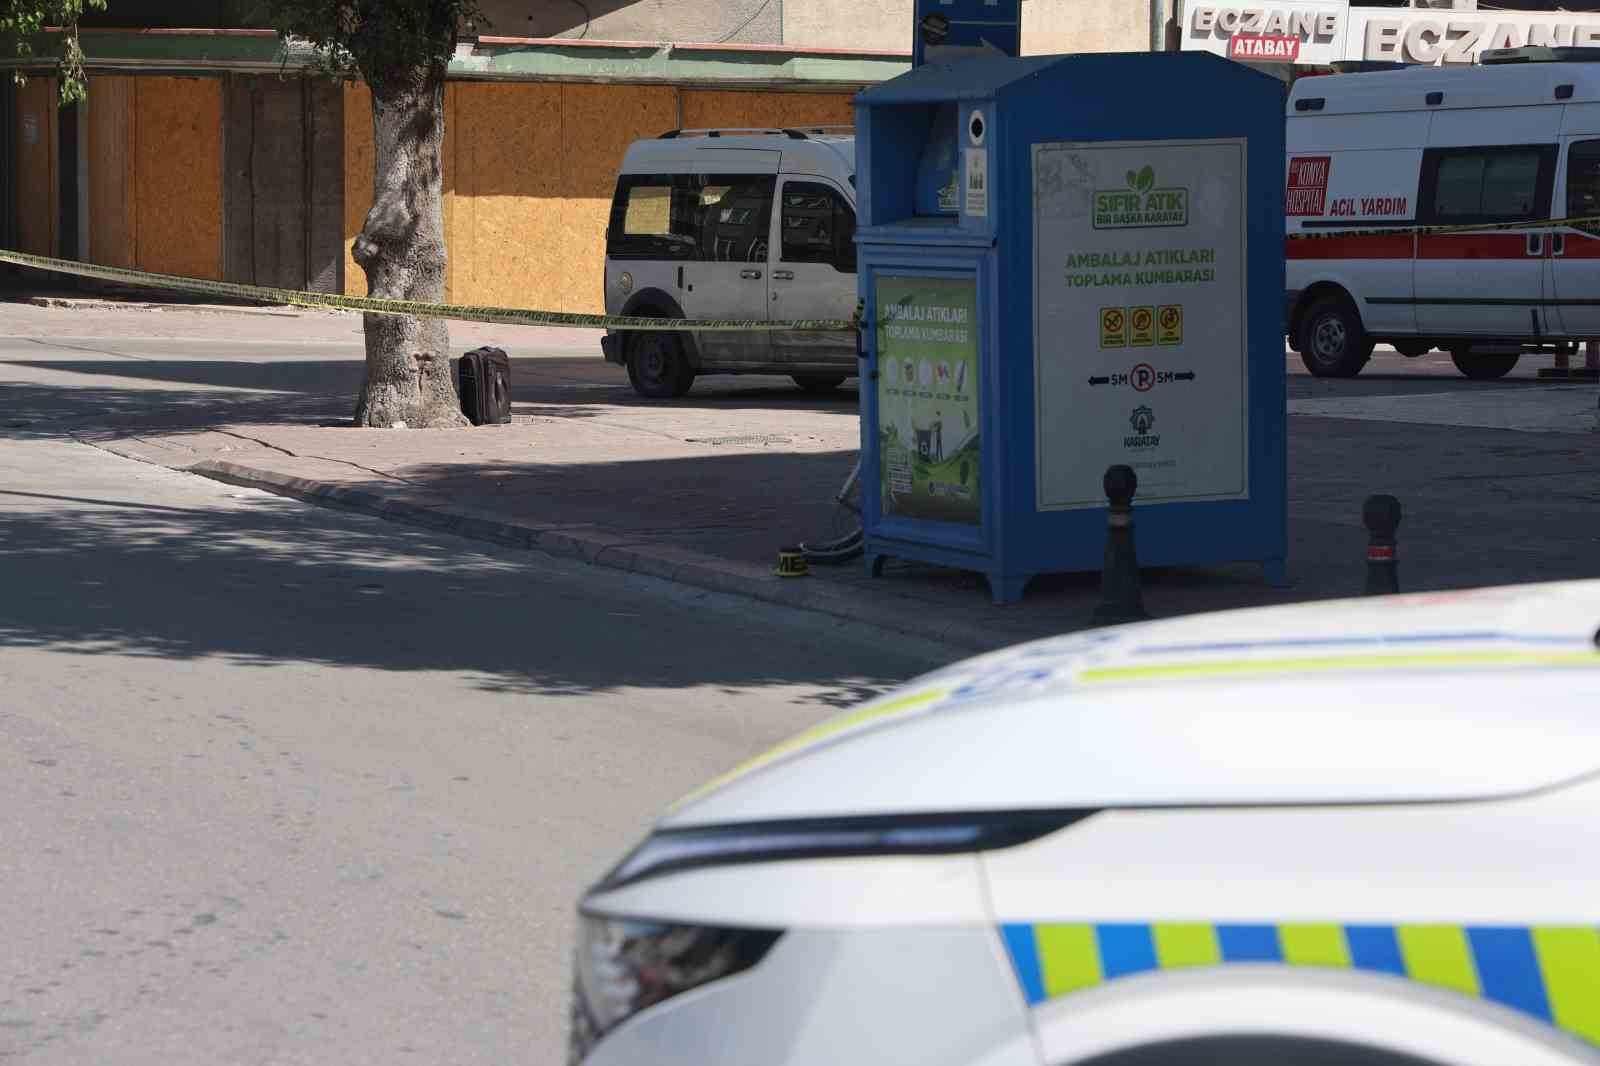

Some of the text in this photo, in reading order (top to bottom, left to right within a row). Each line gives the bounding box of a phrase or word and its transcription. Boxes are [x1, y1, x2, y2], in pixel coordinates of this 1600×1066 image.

[1191, 7, 1338, 43] ECZANE
[1234, 38, 1296, 56] ATABAY
[1298, 161, 1326, 186] KONYA
[1147, 192, 1184, 210] ATIK
[1360, 197, 1408, 216] YARDIM
[1065, 249, 1216, 268] AMBALAJ ATIKLARI
[1065, 269, 1215, 288] TOPLAMA KUMBARASI
